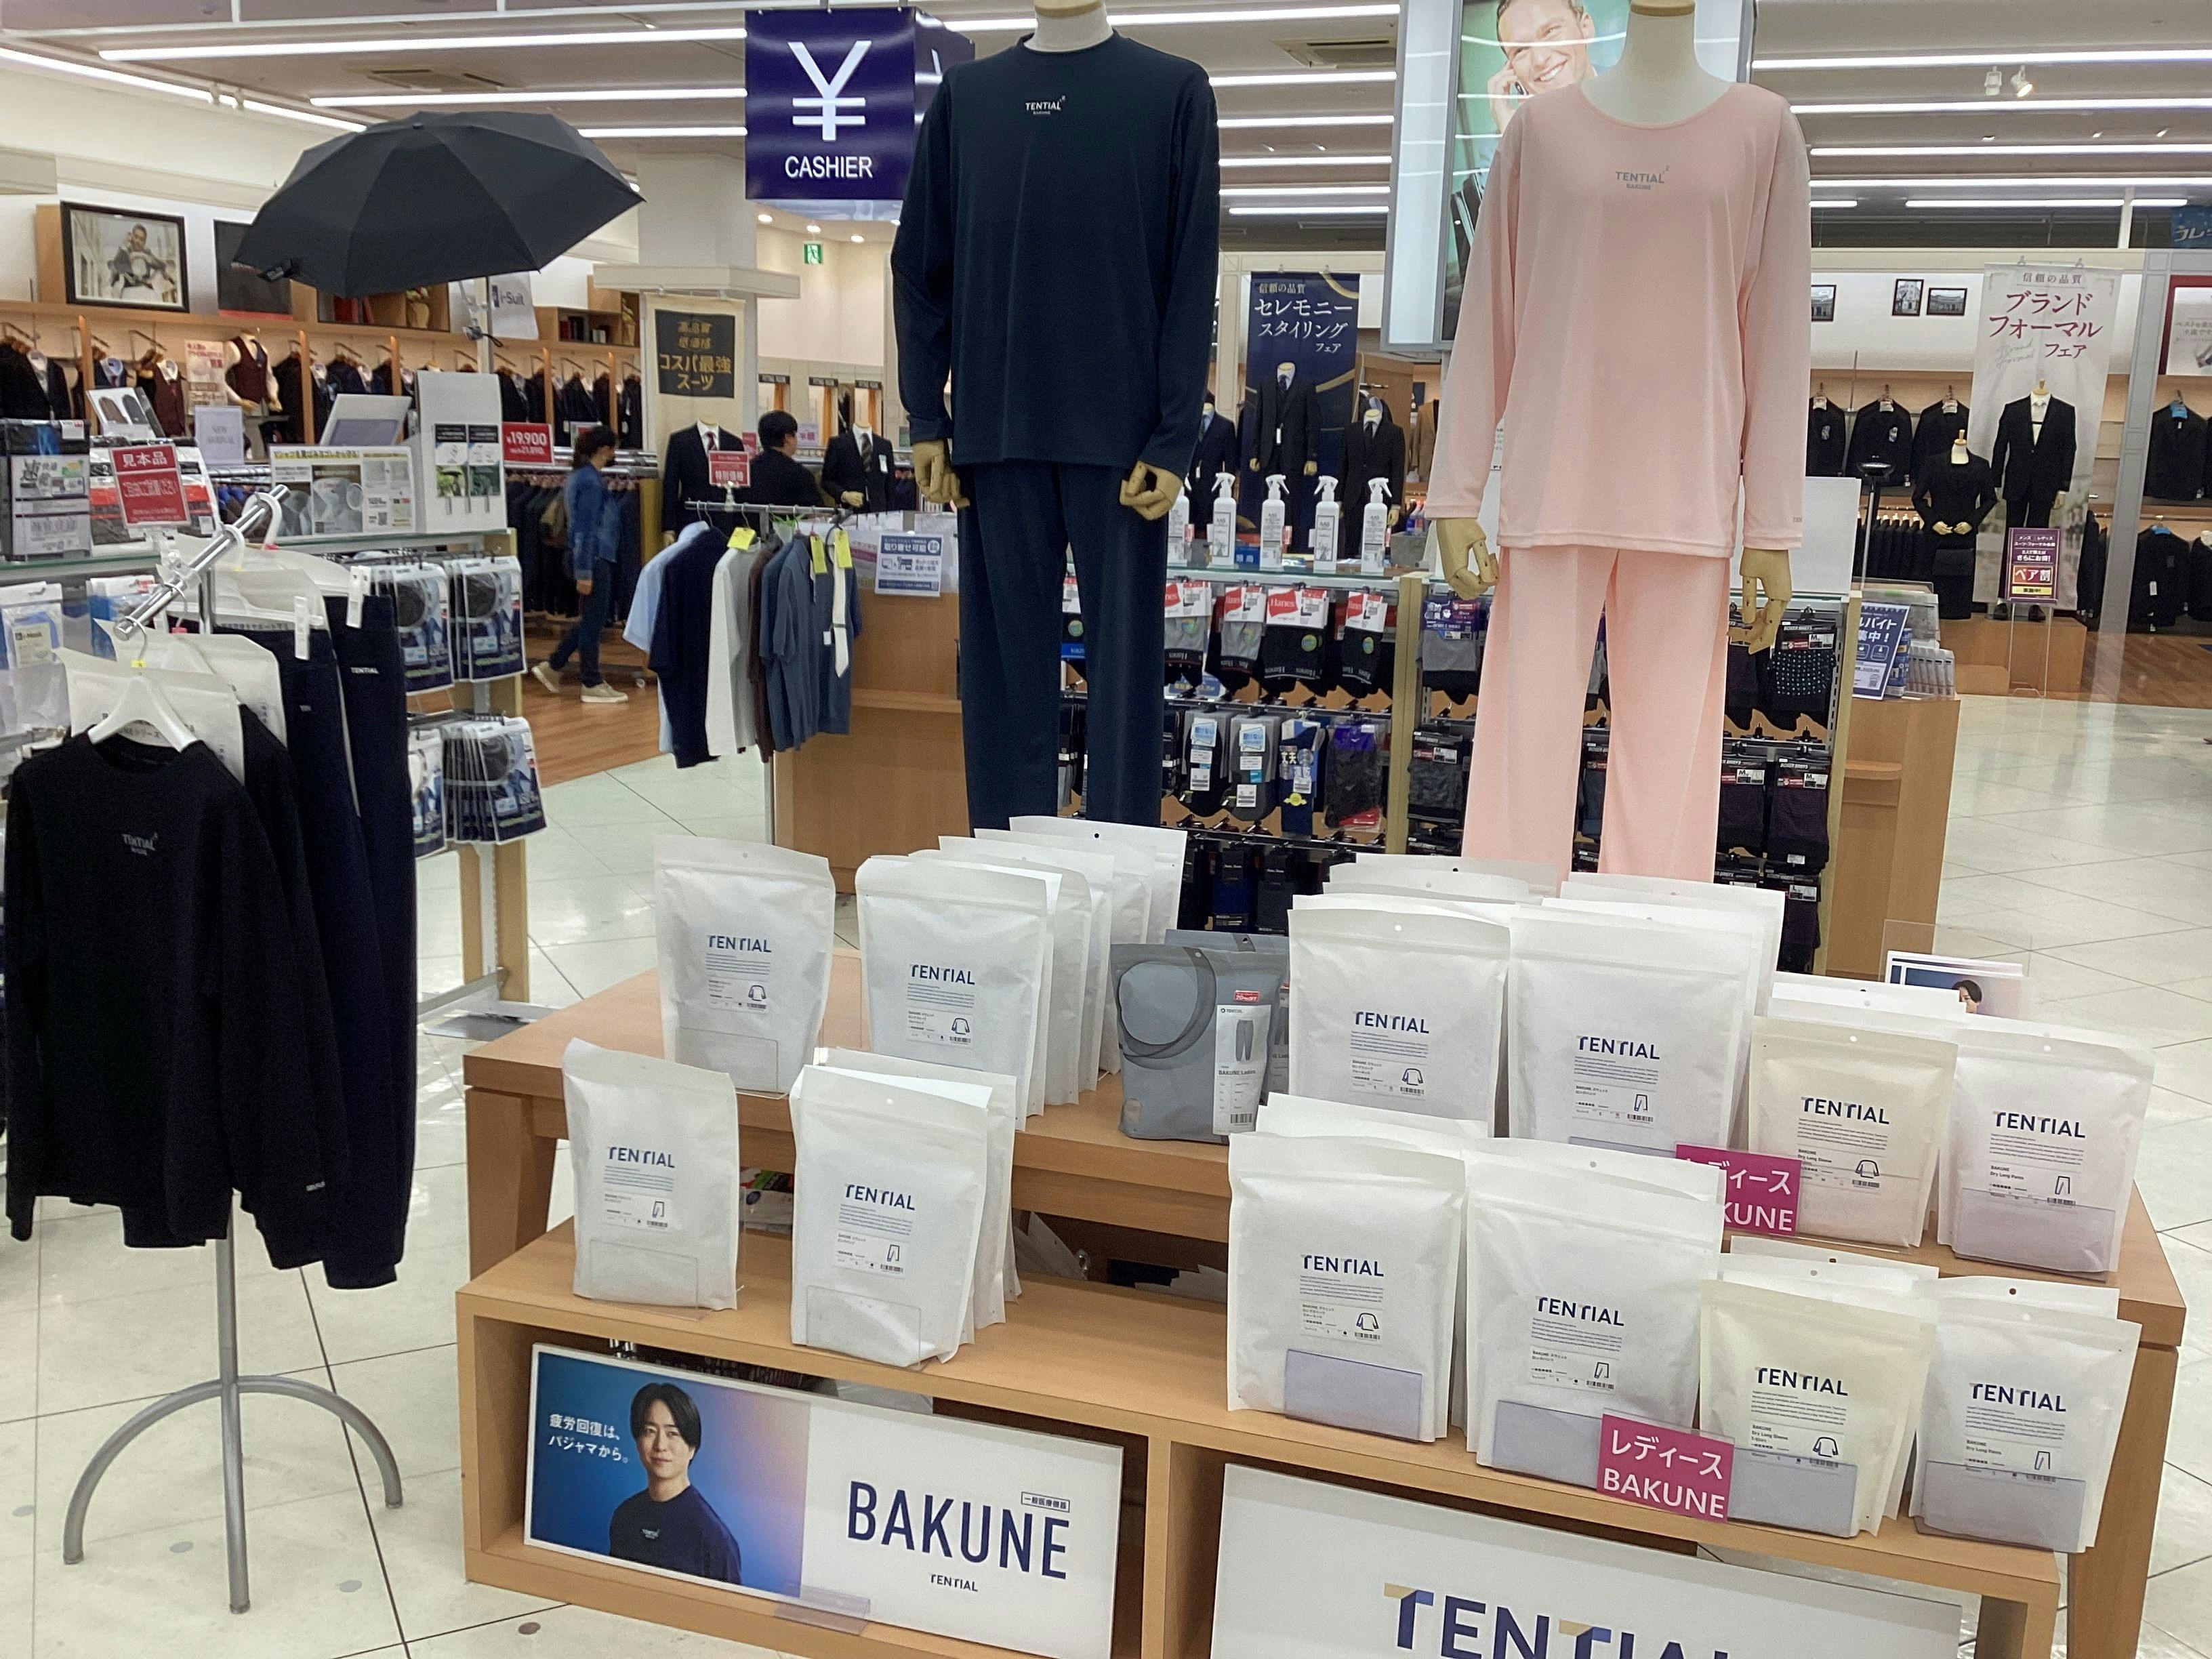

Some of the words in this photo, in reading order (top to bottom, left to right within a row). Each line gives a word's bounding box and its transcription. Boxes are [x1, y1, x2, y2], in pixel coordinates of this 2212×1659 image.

[1025, 101, 1062, 110] TENTIAL
[785, 155, 874, 178] CASHIER
[1615, 171, 1665, 184] TENTIAL
[2023, 272, 2083, 284] 信頼の品質
[1254, 298, 1353, 316] セレモニー
[2006, 290, 2093, 316] ブランド
[1257, 321, 1349, 339] スタイリング
[1989, 315, 2104, 339] フォーマル
[1315, 342, 1342, 353] フェア
[2045, 343, 2087, 359] フェア
[659, 353, 732, 374] コスパ最強
[677, 373, 714, 390] スーツ
[122, 451, 168, 468] 見本品
[1271, 598, 1296, 608] Hanes
[707, 935, 772, 953] TENTIAL
[909, 964, 975, 985] TENTIAL
[1353, 1010, 1429, 1034] TENTIAL
[1576, 1034, 1660, 1060] TENTIAL
[1801, 1096, 1889, 1125] TENTIAL
[1993, 1109, 2086, 1139] TENTIAL
[607, 1146, 675, 1168] TENTIAL
[844, 1184, 916, 1210] TENTIAL
[1300, 1254, 1384, 1277] TENTIAL
[1536, 1295, 1624, 1326] TENTIAL
[1755, 1366, 1848, 1396] TENTIAL
[1969, 1382, 2067, 1412] TENTIAL
[549, 1413, 621, 1441] 疲労回復は、
[548, 1435, 629, 1465] パジャマから。
[1612, 1429, 1723, 1480] レディース
[1603, 1467, 1725, 1519] BAKUNE
[847, 1480, 1069, 1580] BAKUNE
[929, 1574, 979, 1593] TENTIAL
